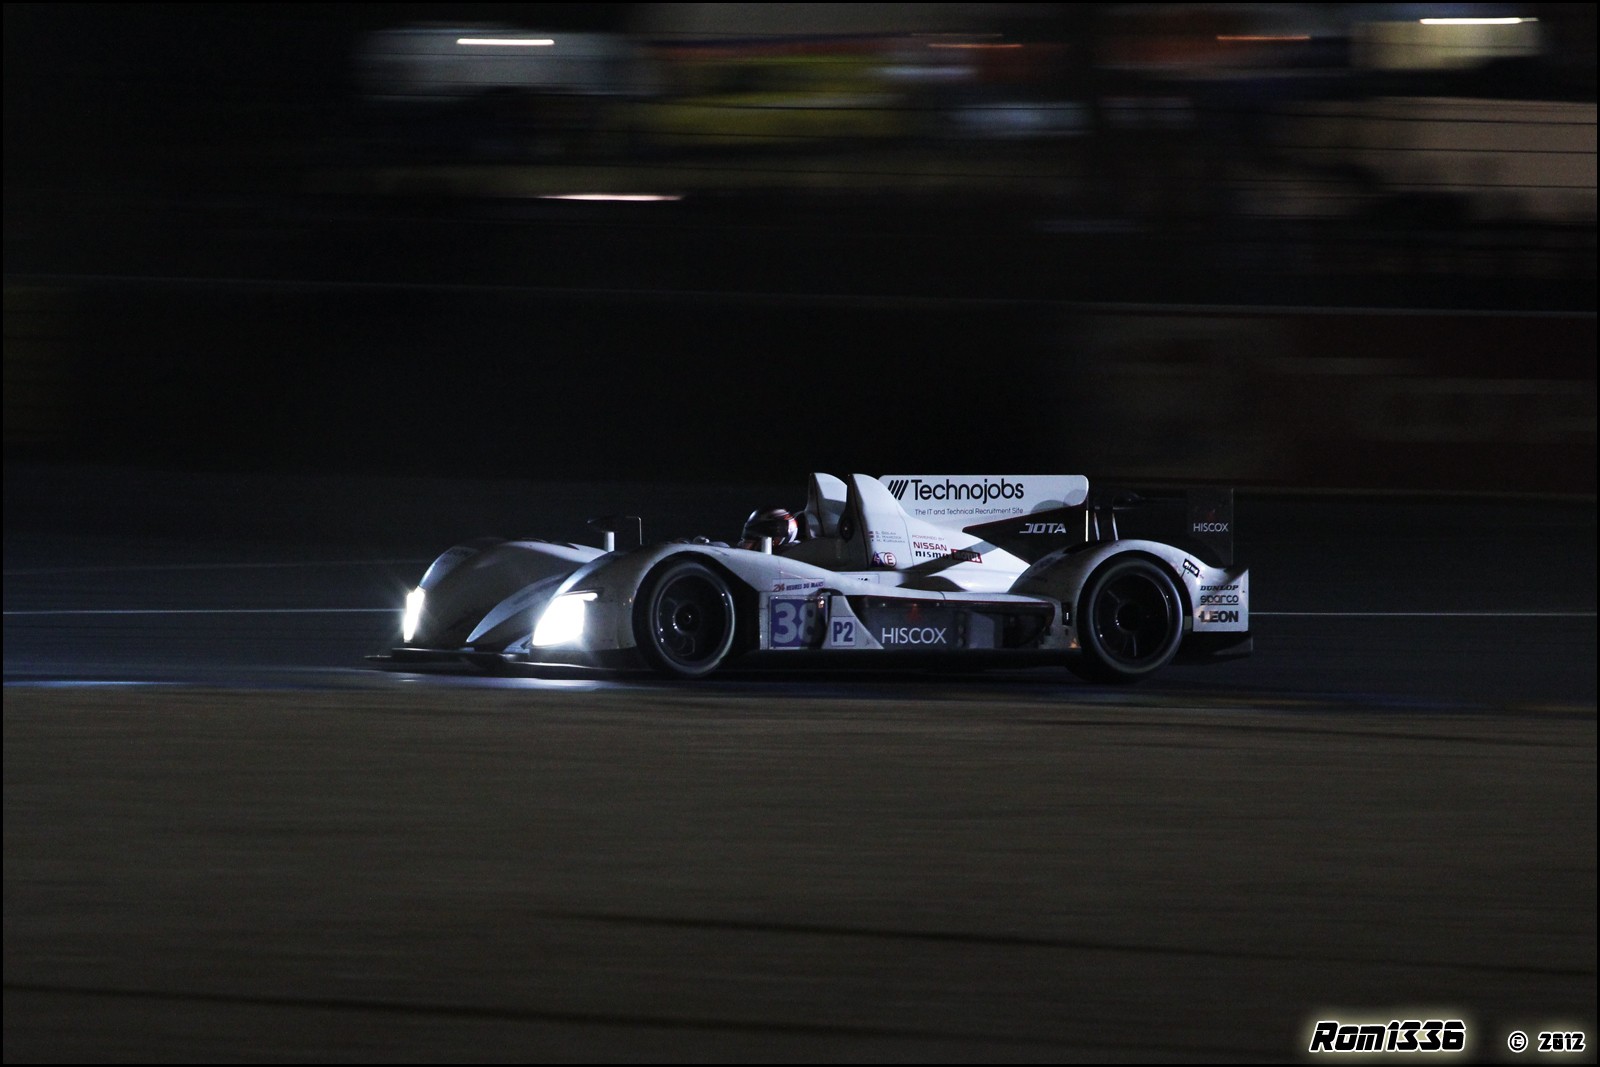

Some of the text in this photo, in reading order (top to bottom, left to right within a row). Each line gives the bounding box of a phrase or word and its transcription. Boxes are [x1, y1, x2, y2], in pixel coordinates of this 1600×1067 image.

[911, 478, 1024, 505] Technojobs
[1019, 523, 1067, 534] JOTA
[1193, 523, 1229, 532] HISCOX
[913, 542, 947, 551] NISSAN
[1200, 594, 1239, 604] sparco
[1200, 611, 1239, 623] LEON
[773, 602, 818, 645] 38
[833, 621, 853, 642] P2
[881, 627, 947, 644] HISCOX
